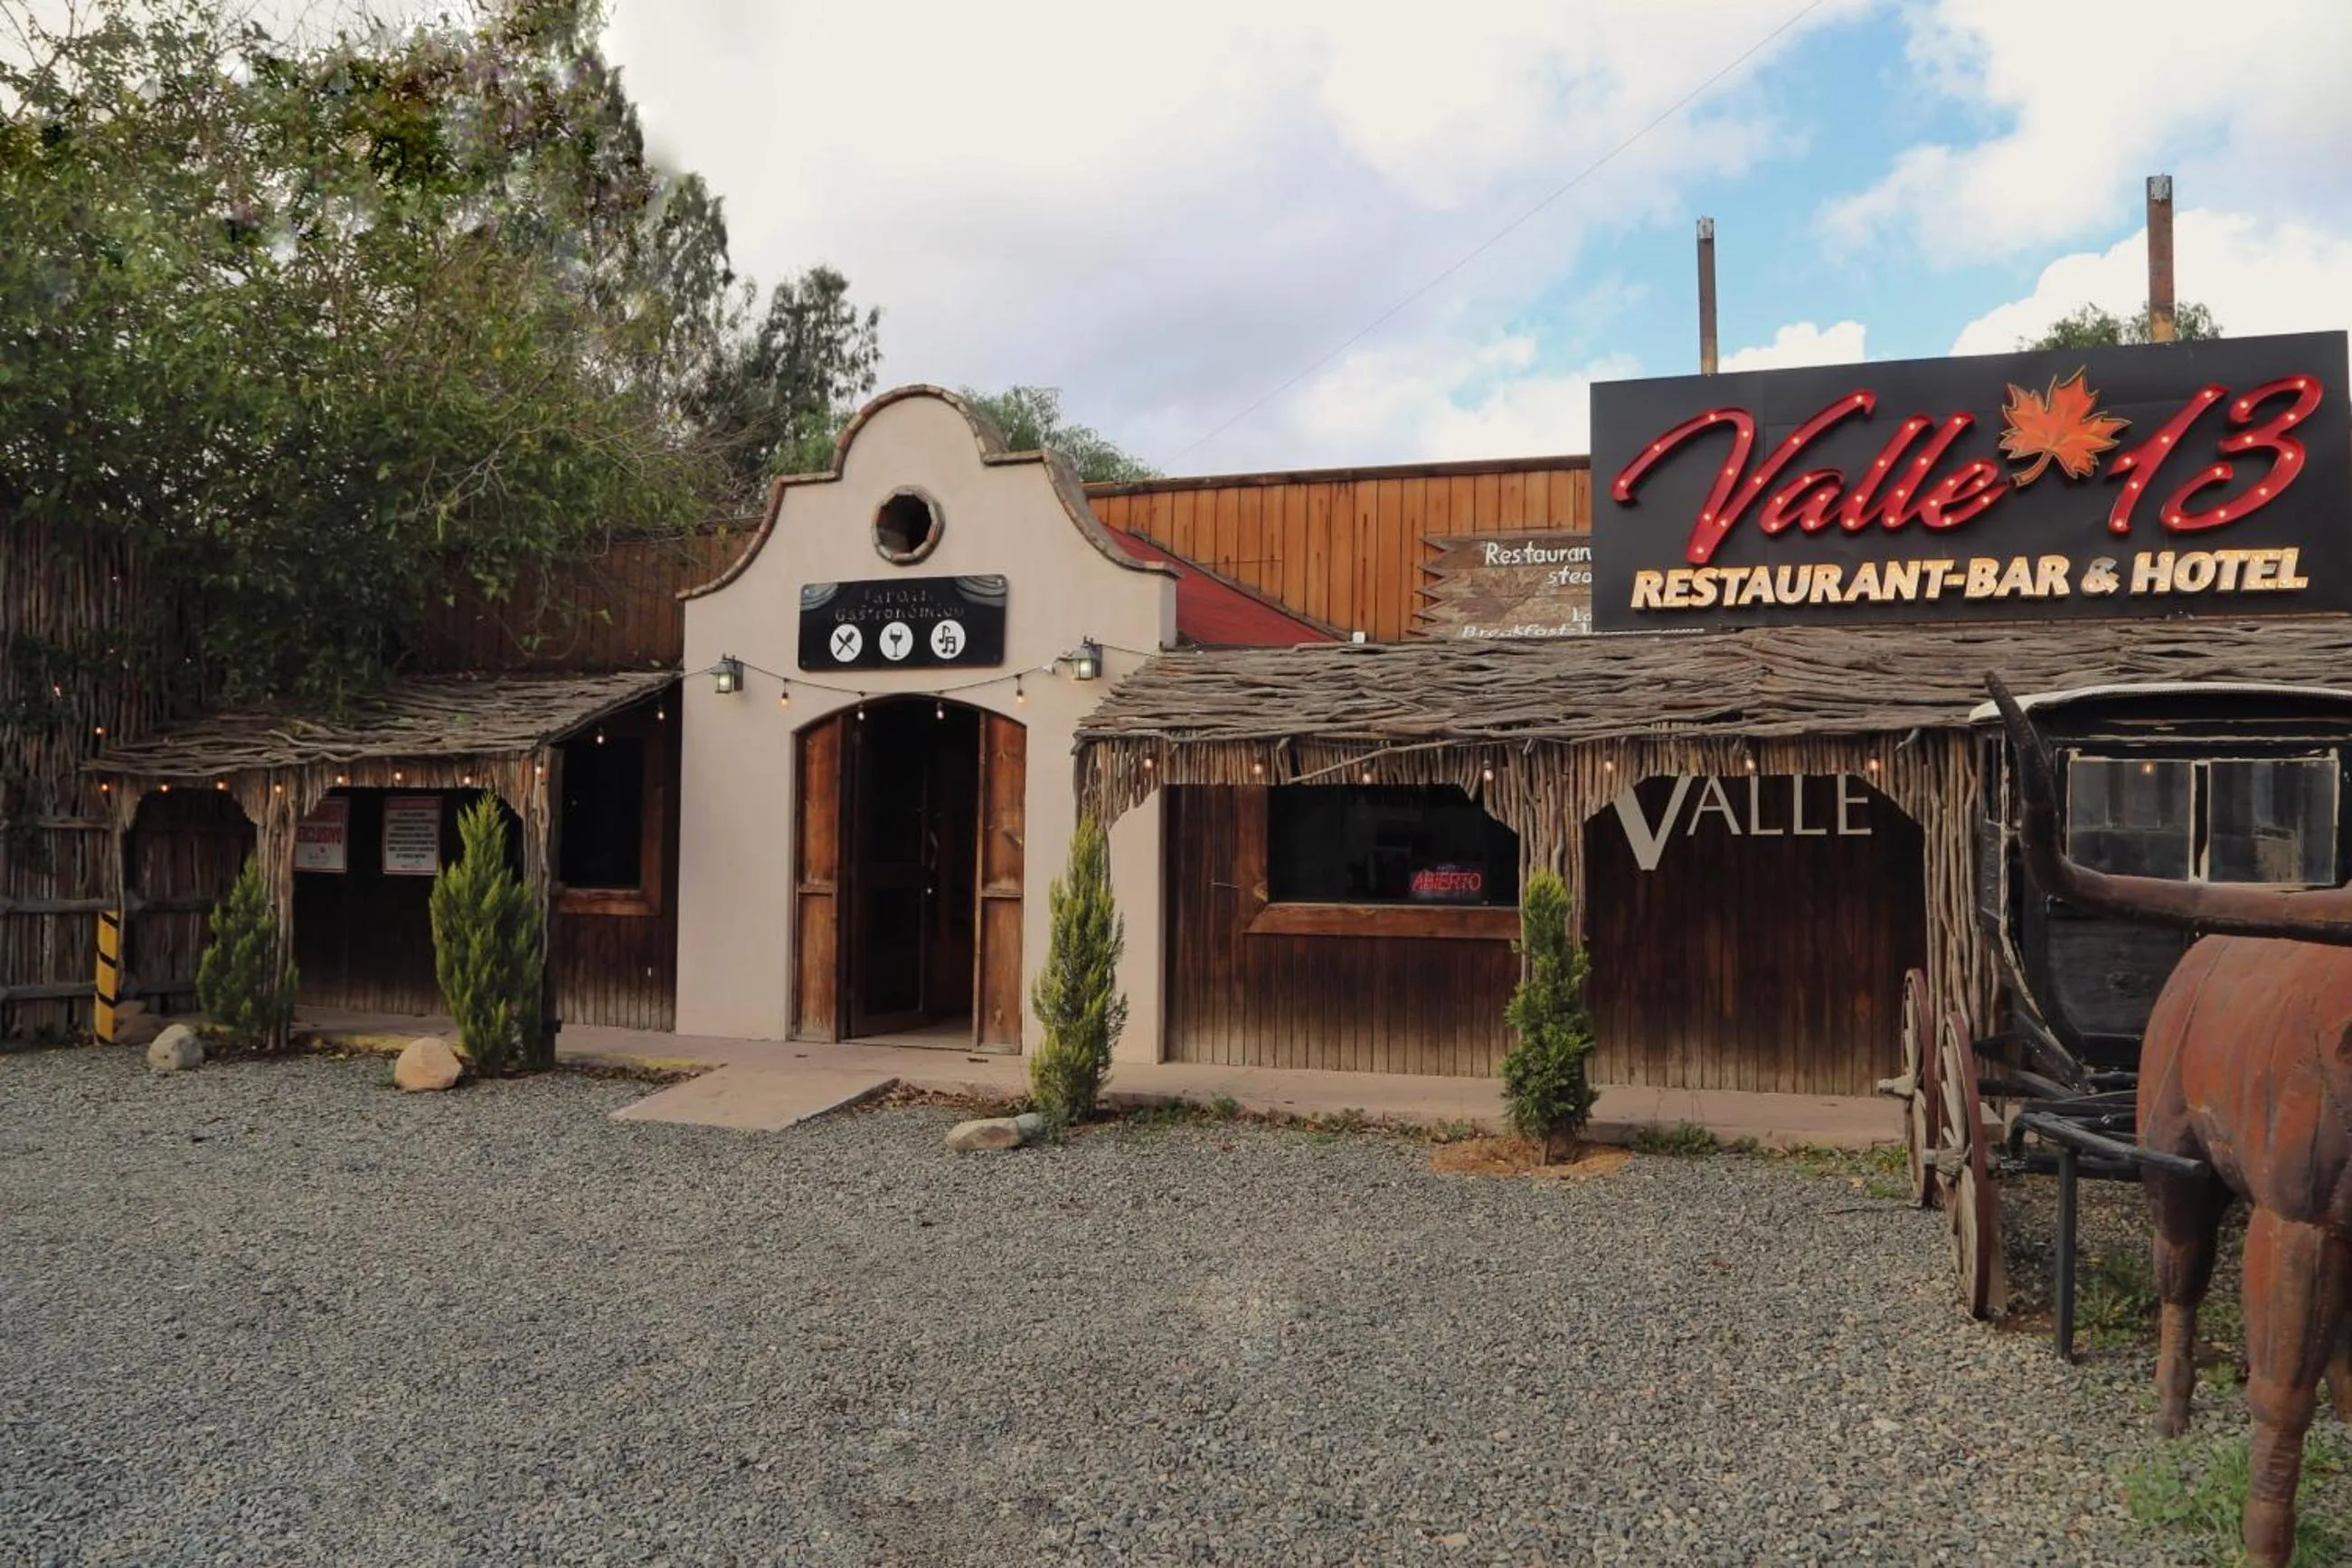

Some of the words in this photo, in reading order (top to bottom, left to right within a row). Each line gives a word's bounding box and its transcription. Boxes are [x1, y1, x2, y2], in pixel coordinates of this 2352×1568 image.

[1611, 389, 2008, 564] Valle
[2106, 374, 2323, 534] 13
[1630, 553, 2073, 610] RESTAURANT-BAR
[2081, 556, 2119, 598] &
[2130, 547, 2309, 595] HOTEL
[1613, 774, 1873, 871] VALLE
[1412, 869, 1482, 891] ABIERTO
